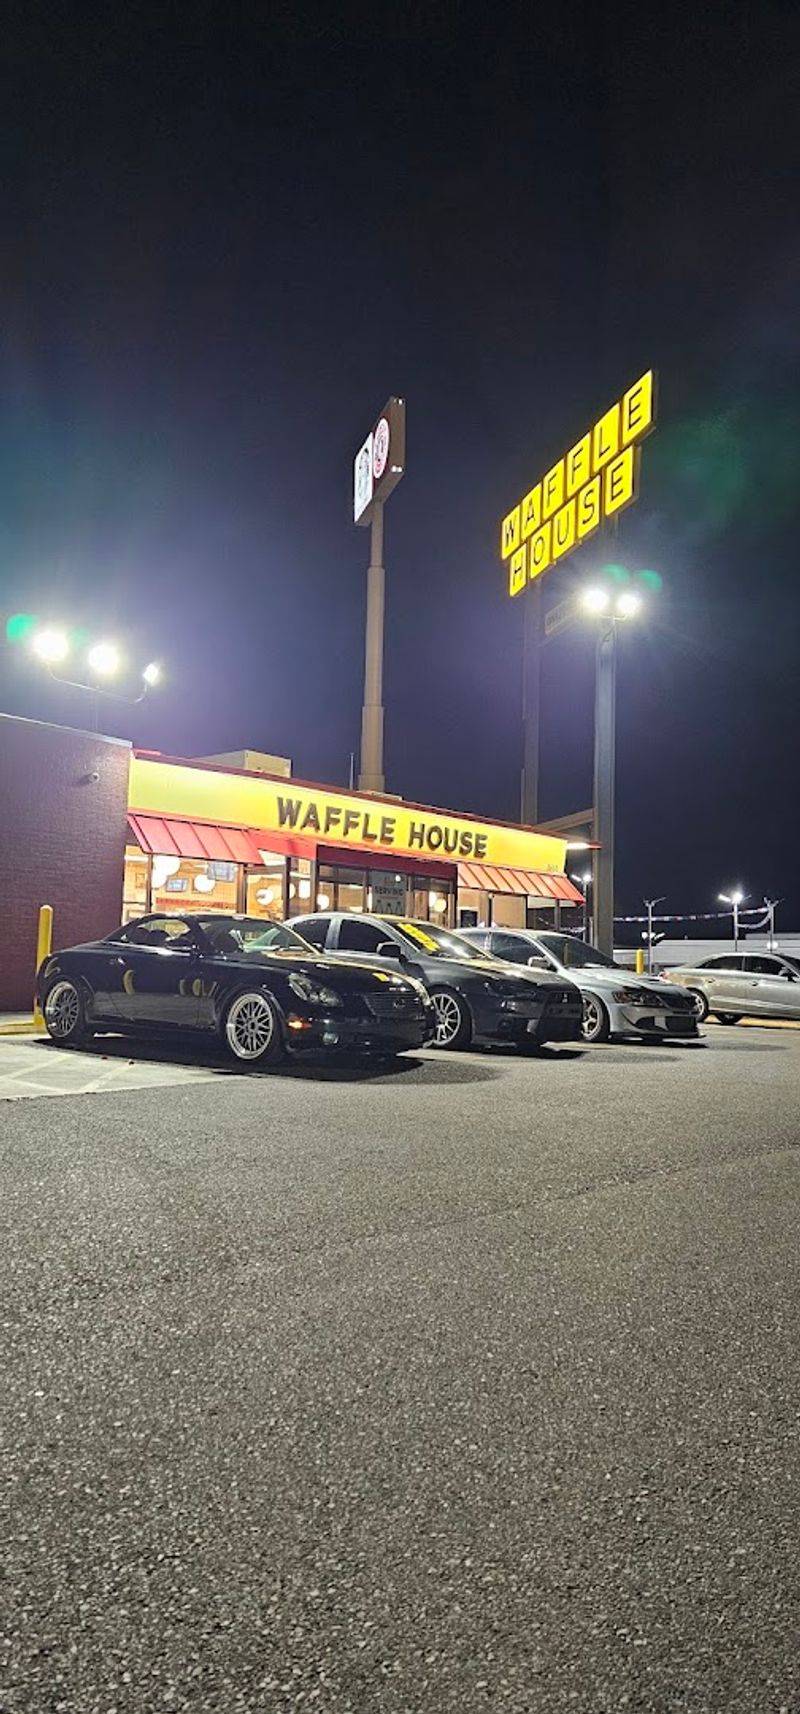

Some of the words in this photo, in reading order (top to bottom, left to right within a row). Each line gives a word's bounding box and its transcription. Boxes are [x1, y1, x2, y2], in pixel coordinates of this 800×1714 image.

[505, 386, 643, 548] WAFFLE
[512, 461, 624, 588] HOUSE
[276, 796, 396, 845] WAFFLE
[407, 821, 488, 858] HOUSE
